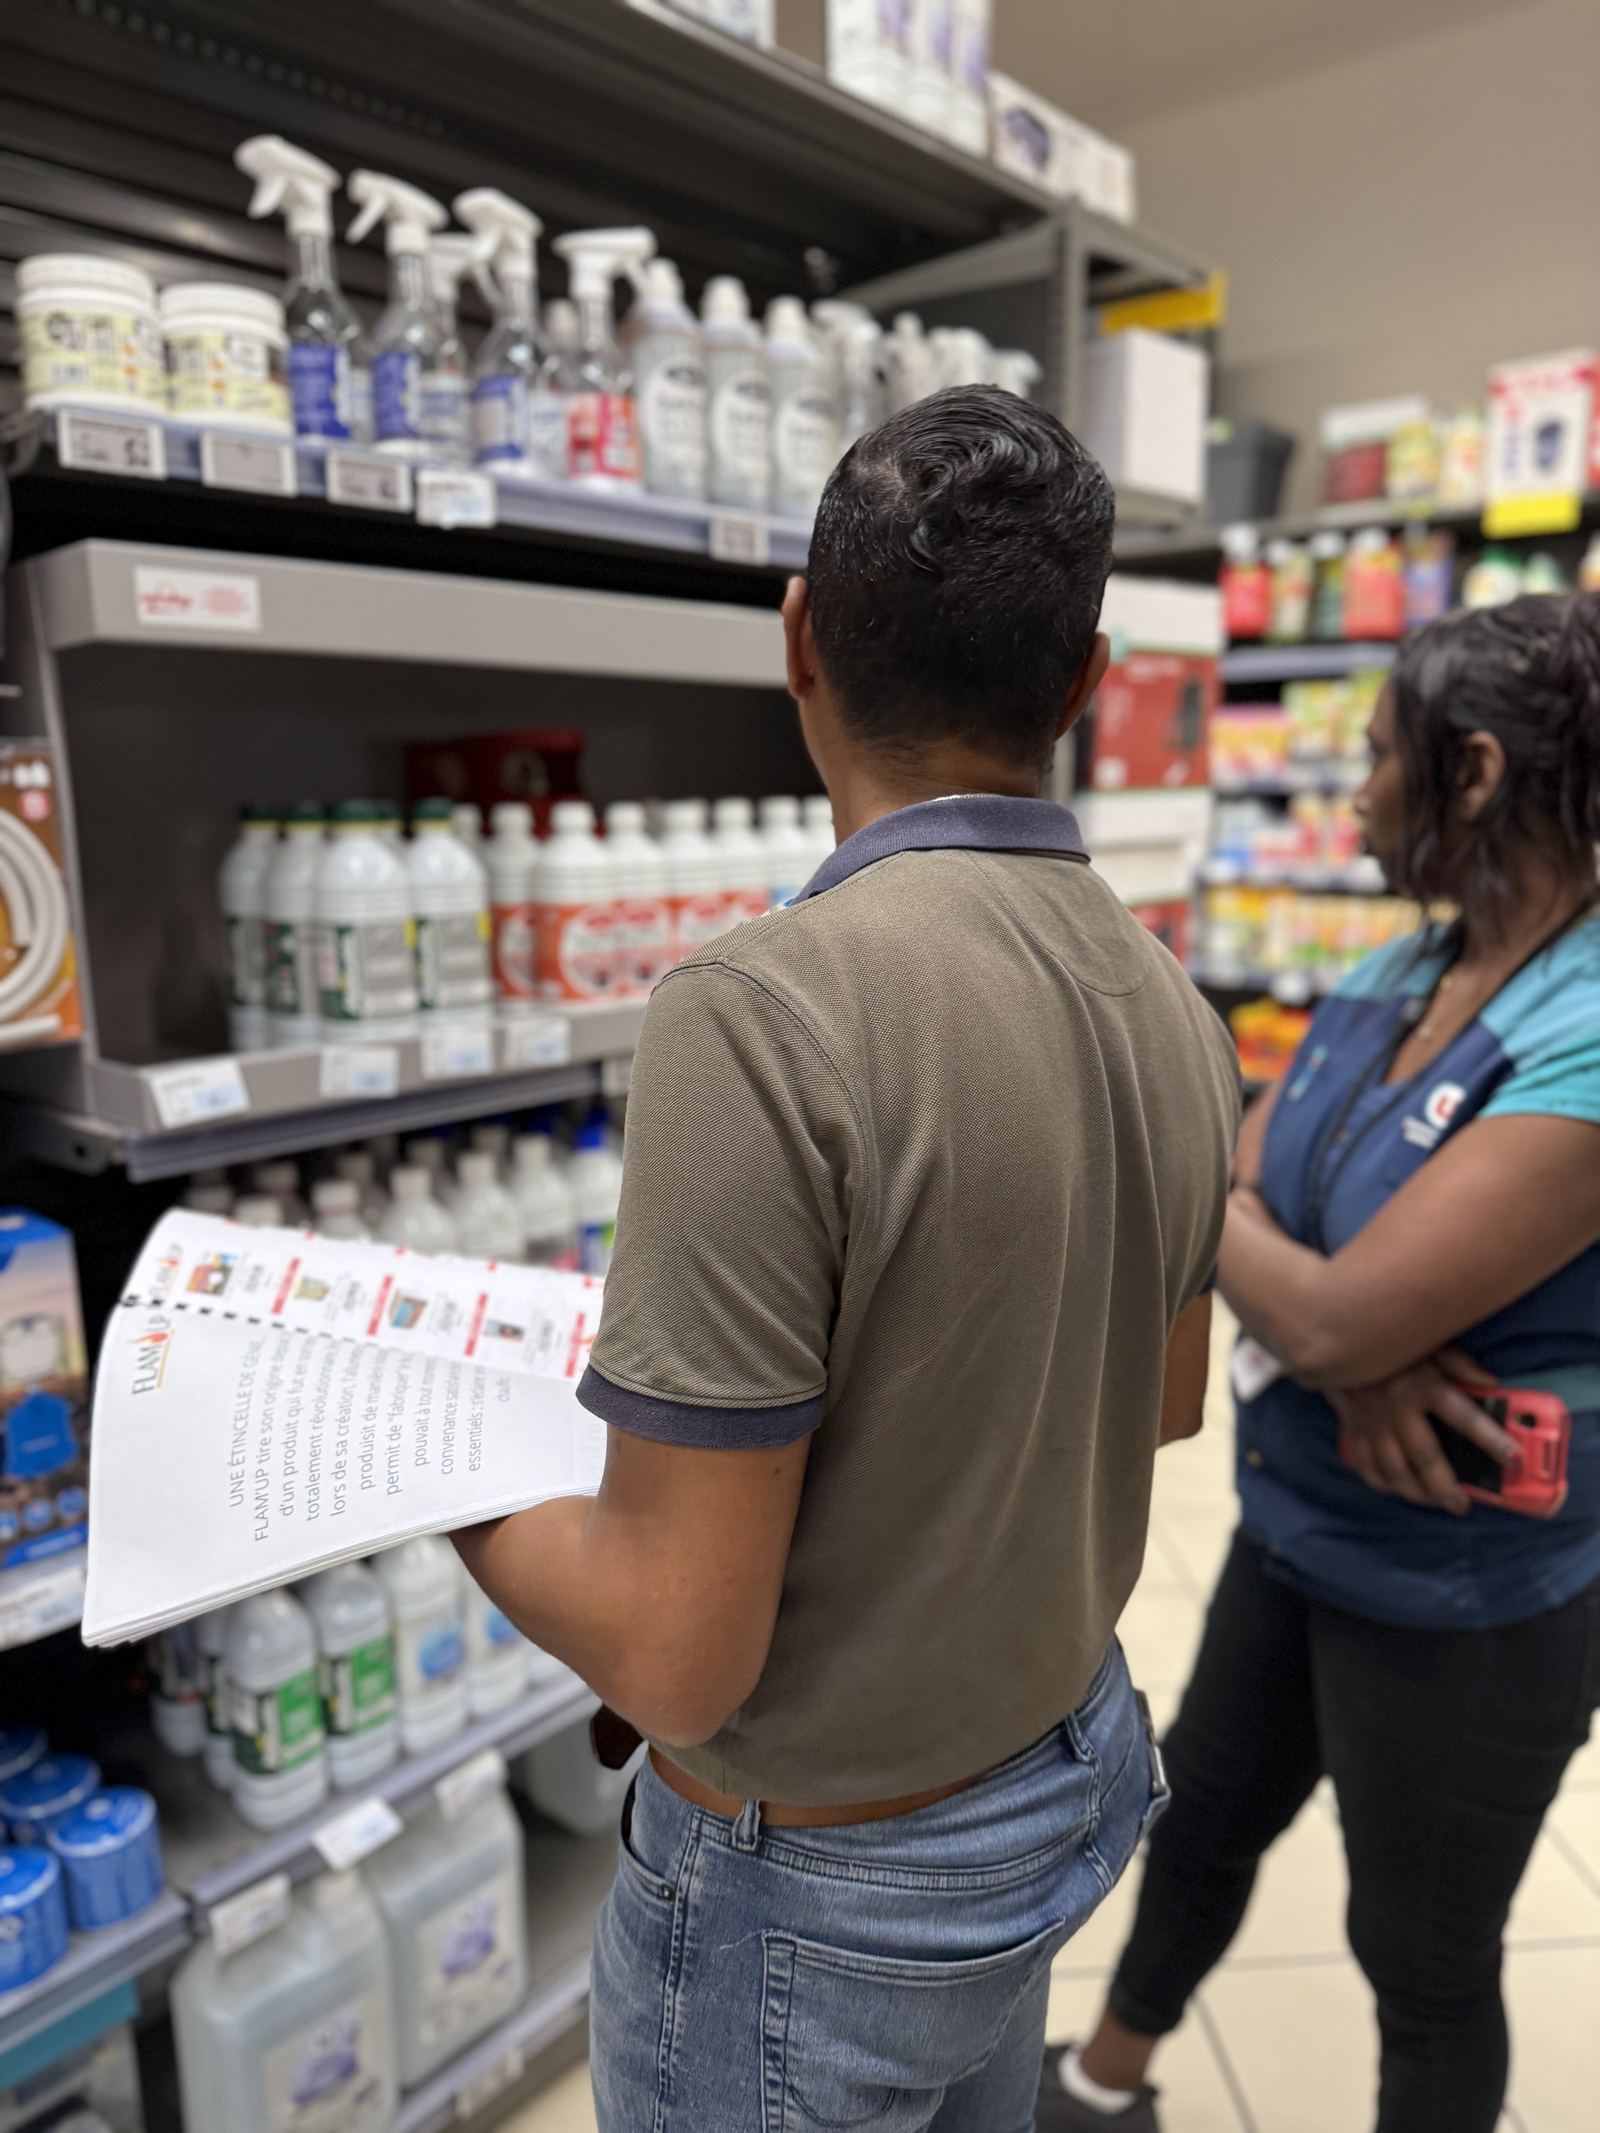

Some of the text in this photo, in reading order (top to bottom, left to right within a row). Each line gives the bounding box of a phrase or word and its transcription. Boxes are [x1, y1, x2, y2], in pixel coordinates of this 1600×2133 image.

[238, 1369, 256, 1387] DE
[263, 1364, 284, 1404] origine
[287, 1378, 305, 1394] fut
[286, 1396, 304, 1417] qui
[336, 1383, 356, 1435] création,
[362, 1406, 378, 1421] de
[418, 1387, 432, 1406] tout
[227, 1390, 252, 1467] ÉTINCELLE
[261, 1408, 274, 1433] son
[386, 1425, 402, 1441] de
[440, 1402, 457, 1474] convenance
[256, 1437, 272, 1464] tire
[281, 1420, 298, 1476] produit
[335, 1440, 349, 1456] sa
[358, 1425, 376, 1490] produisit
[412, 1418, 431, 1466] pouvait
[466, 1412, 484, 1471] essentiels
[305, 1434, 323, 1521] totalement
[331, 1460, 347, 1479] de
[384, 1444, 403, 1495] permit
[229, 1470, 245, 1507] UNE
[254, 1468, 270, 1541] FLAM'UP
[278, 1481, 295, 1516] d'un
[330, 1484, 346, 1516] lors
